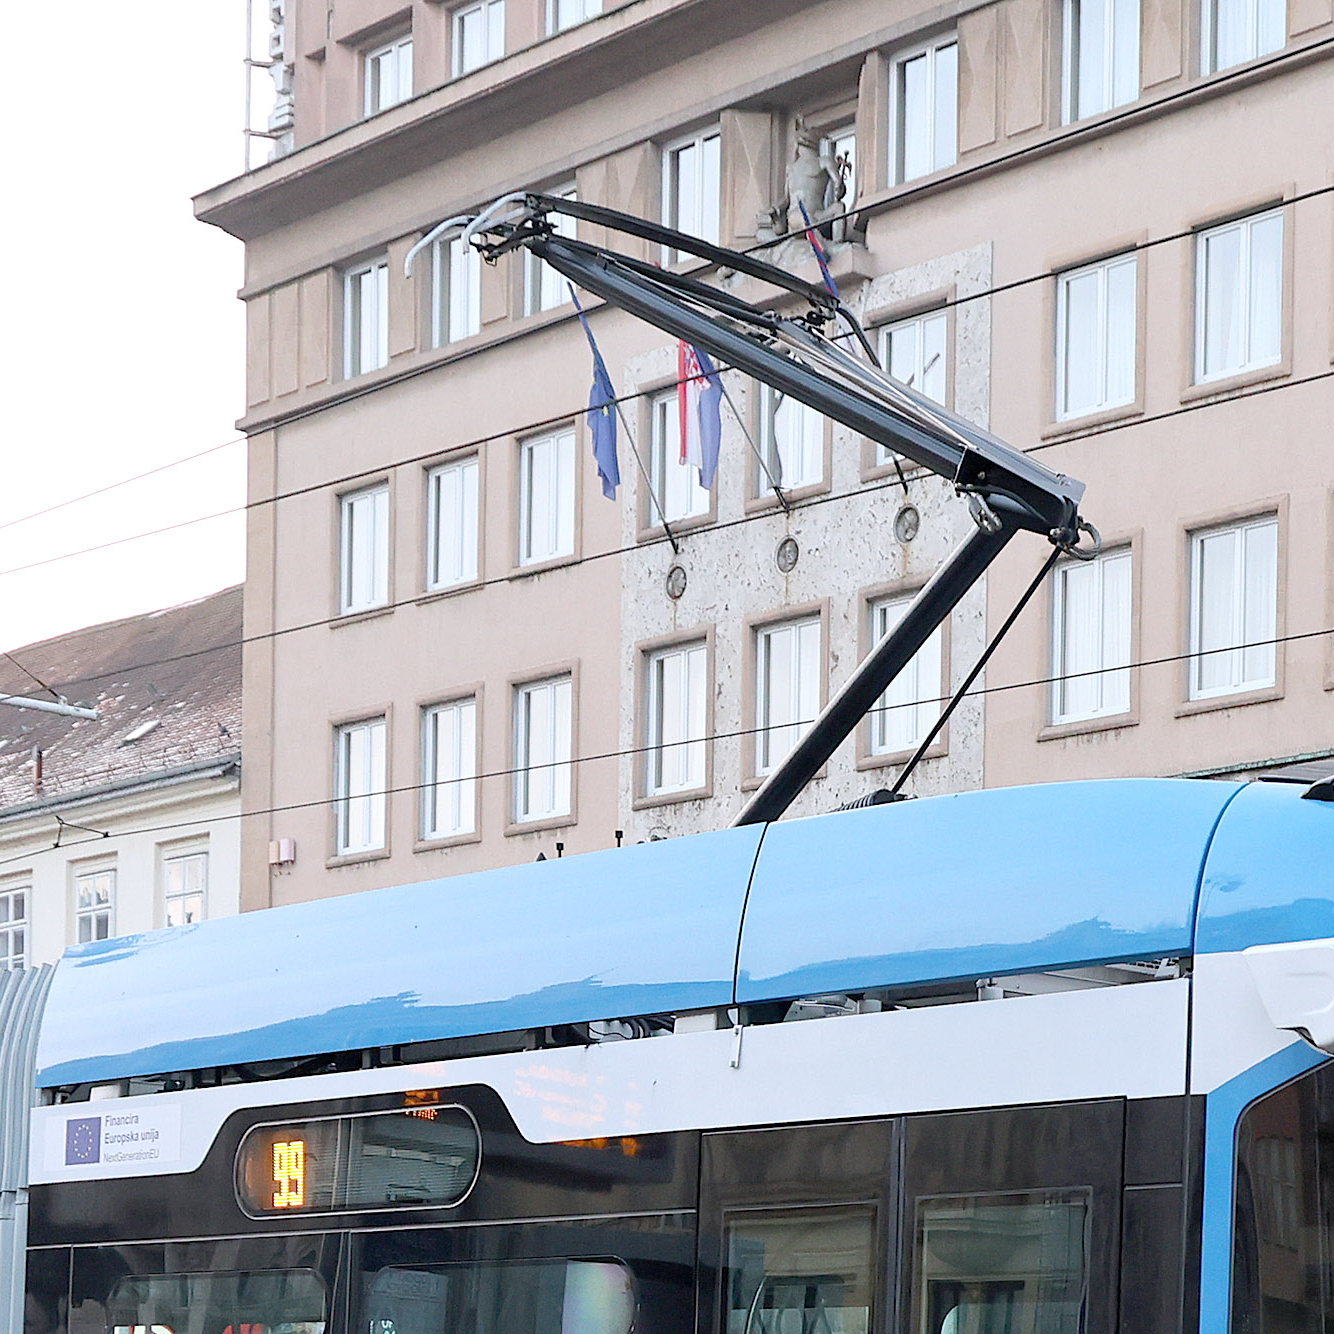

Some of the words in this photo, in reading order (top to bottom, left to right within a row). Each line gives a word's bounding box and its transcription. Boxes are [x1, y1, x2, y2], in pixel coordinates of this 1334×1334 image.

[104, 1114, 139, 1127] Financira
[104, 1131, 139, 1146] Europska
[140, 1128, 160, 1143] unija
[103, 1148, 160, 1164] NextGenerationEU
[272, 1140, 305, 1208] 99
